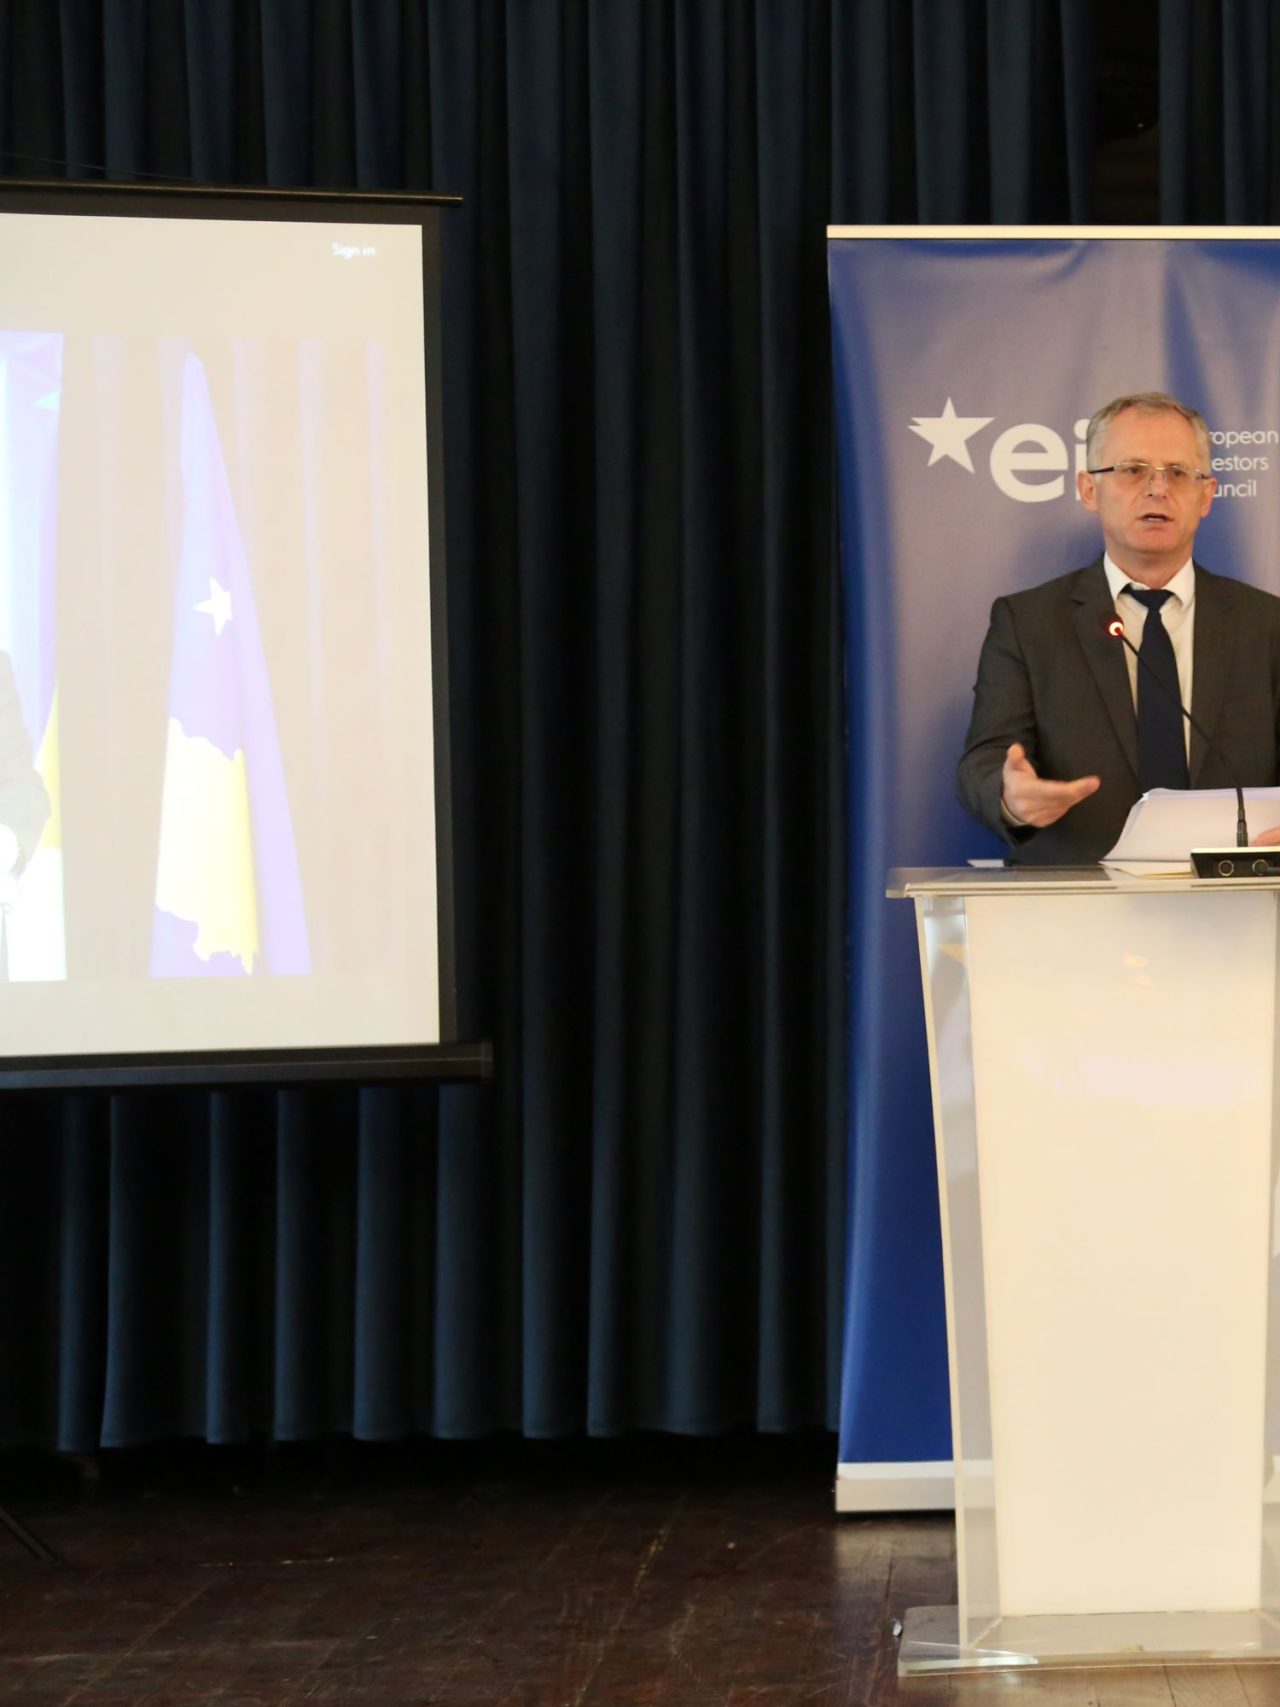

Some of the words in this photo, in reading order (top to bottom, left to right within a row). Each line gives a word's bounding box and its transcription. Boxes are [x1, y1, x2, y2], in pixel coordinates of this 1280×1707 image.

[332, 242, 360, 259] Sign
[361, 245, 376, 256] in
[1211, 456, 1269, 471] estors
[1213, 479, 1257, 497] uncil
